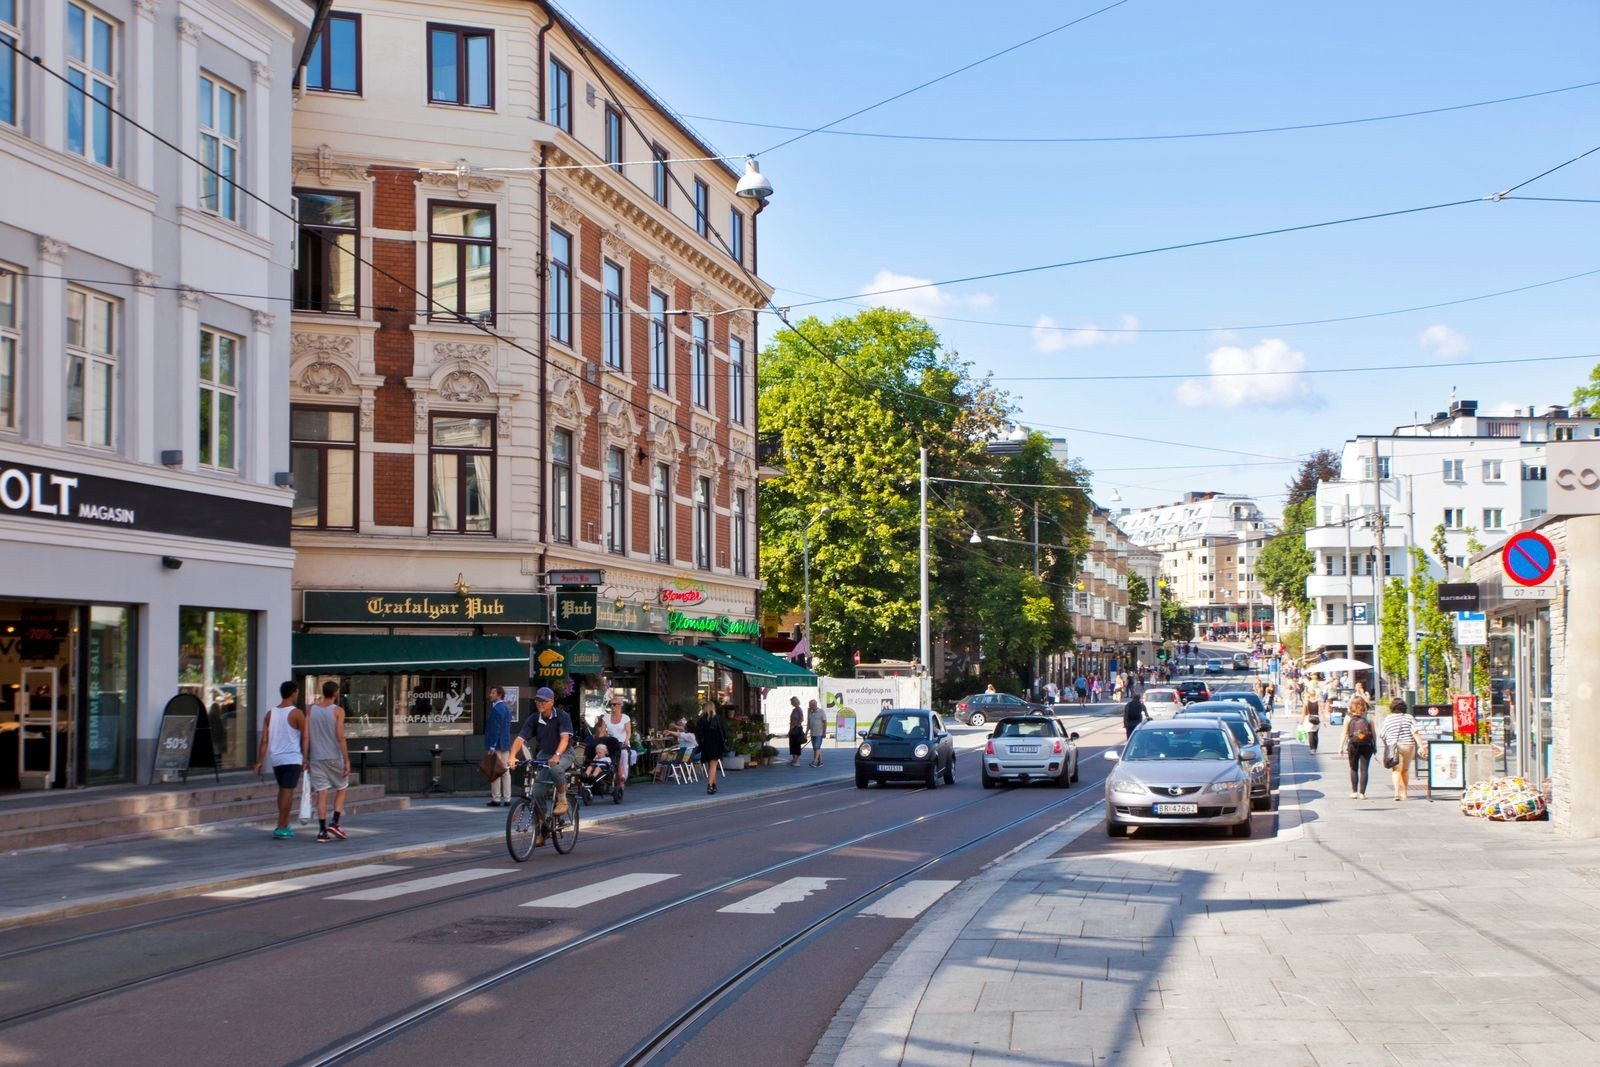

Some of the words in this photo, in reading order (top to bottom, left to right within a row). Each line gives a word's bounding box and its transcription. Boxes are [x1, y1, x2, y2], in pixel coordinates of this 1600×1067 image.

[0, 468, 78, 515] OLT
[79, 503, 135, 523] MAGASIN
[661, 588, 702, 603] Blomster
[1514, 589, 1525, 597] 07
[1537, 589, 1546, 597] 17
[366, 596, 460, 619] Trafalgar
[464, 596, 505, 619] Pub
[560, 600, 593, 619] Pub
[1355, 607, 1365, 617] P
[668, 611, 720, 635] Blomster
[539, 668, 564, 677] TOTO
[408, 690, 444, 699] Football
[393, 714, 456, 723] TRAFALGAR
[163, 737, 188, 749] -50%
